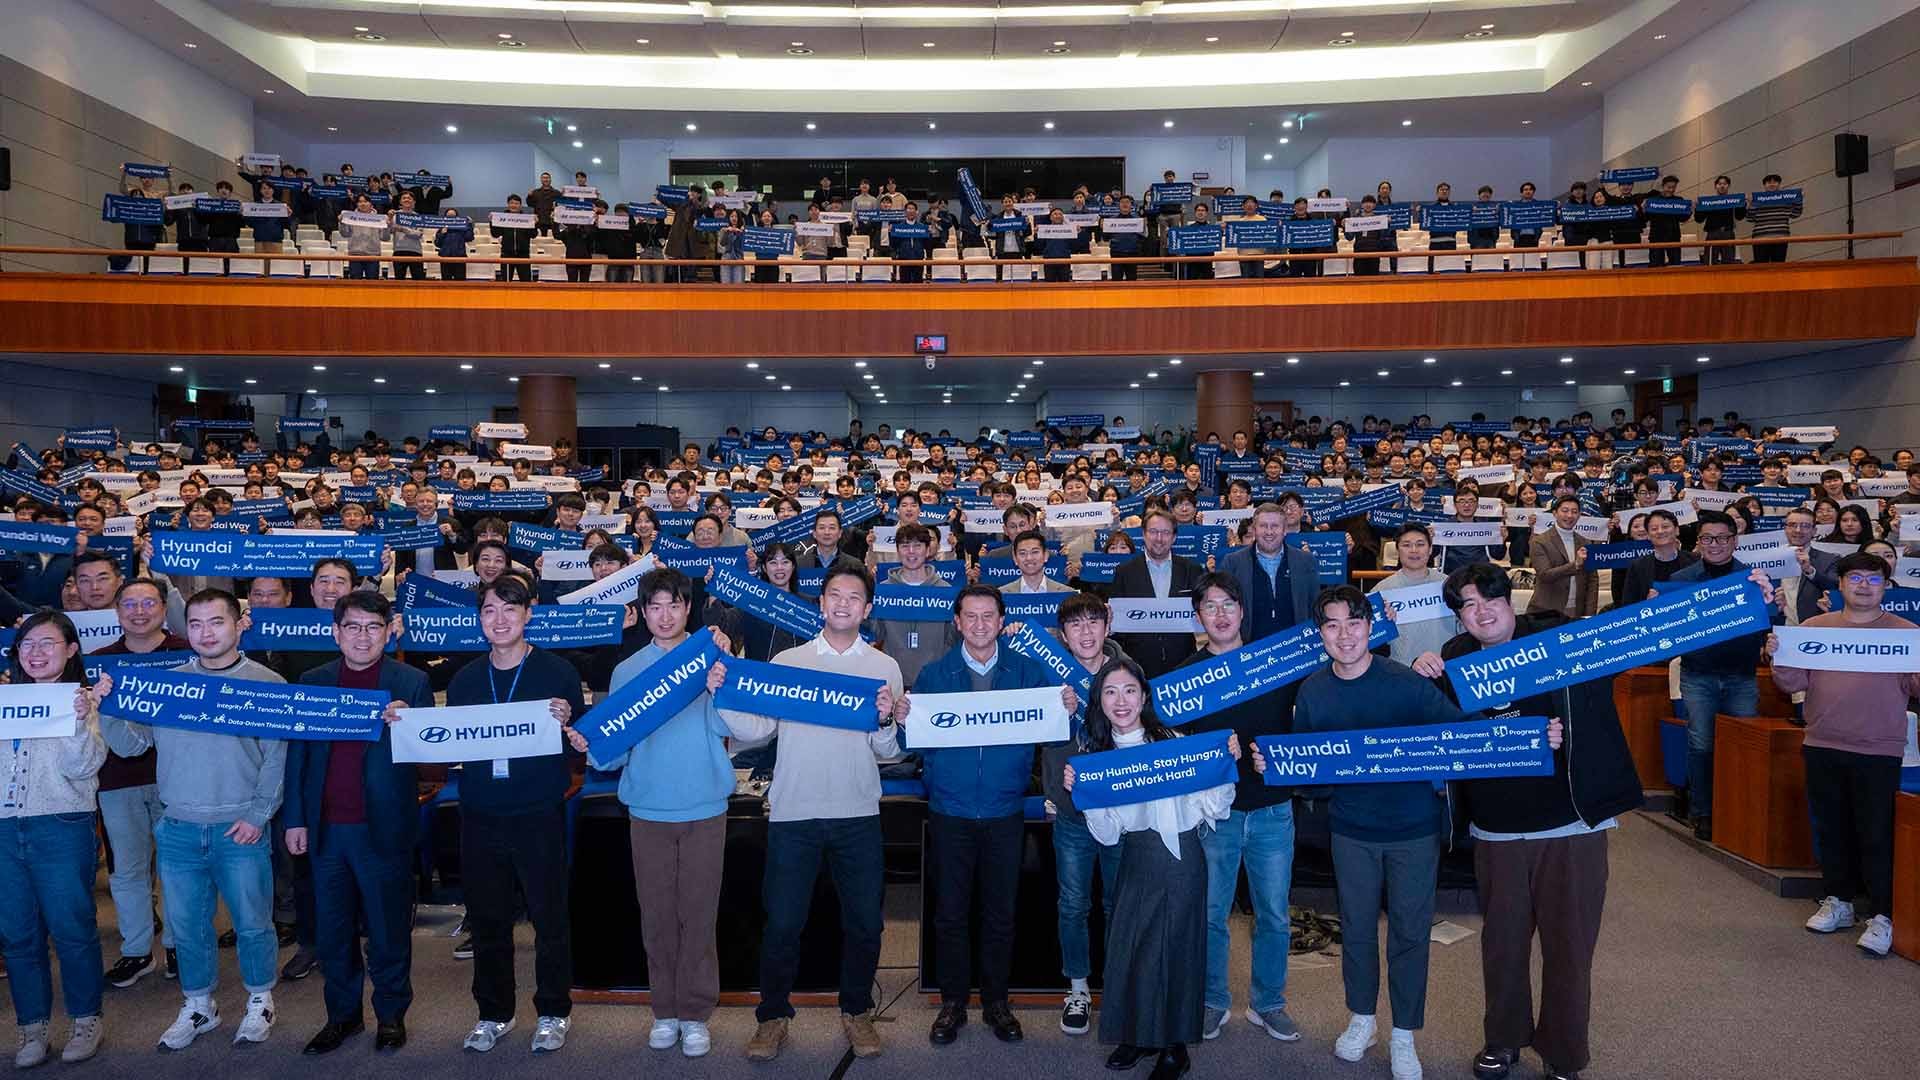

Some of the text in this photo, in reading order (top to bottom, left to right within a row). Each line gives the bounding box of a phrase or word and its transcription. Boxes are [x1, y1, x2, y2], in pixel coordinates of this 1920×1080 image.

[455, 494, 486, 503] Hyundai
[926, 512, 946, 521] Way
[1069, 511, 1102, 519] HYUNDAI
[1312, 504, 1342, 516] Hyundai
[1373, 510, 1403, 519] Hyundai
[229, 521, 250, 530] Way
[584, 522, 618, 530] HYUNDAI
[1314, 514, 1331, 524] Way
[1374, 516, 1390, 525] Way
[103, 525, 126, 534] NDAI
[515, 528, 556, 541] Hyundai
[40, 532, 70, 546] Way
[161, 539, 232, 554] Hyundai
[515, 536, 537, 548] Way
[1200, 534, 1208, 554] Way
[162, 554, 200, 571] Way
[667, 557, 712, 569] Hyundai
[1595, 551, 1635, 562] Hyundai
[1747, 560, 1785, 569] YUNDAI
[715, 580, 745, 602] Way
[718, 568, 770, 599] Hyundai
[404, 582, 416, 610] ndai
[873, 595, 954, 611] Hyundai Way
[1408, 595, 1442, 609] HYUN
[1577, 582, 1743, 640] Safety and Quality Alignment Progress
[1880, 600, 1908, 612] ndai
[261, 622, 333, 638] Hyunda
[408, 614, 477, 630] Hyundai
[79, 625, 122, 638] HYUN
[410, 630, 446, 645] Way
[1565, 601, 1736, 660] Integrity Tenacity Resilience Expertise
[1018, 623, 1074, 679] Hyundai
[1280, 650, 1304, 663] Tenacity
[1535, 614, 1754, 686] Agility Data-Driven Thinking Diversity and Inclusion
[1831, 644, 1909, 656] HYUNDAI
[1460, 642, 1548, 683] Hyundai
[119, 675, 207, 701] Hyundai
[1156, 661, 1231, 702] Hyundai
[1471, 676, 1516, 701] Way
[236, 689, 256, 698] Safety
[256, 691, 268, 699] and
[269, 692, 291, 701] Quality
[306, 696, 336, 705] Alignment
[600, 651, 709, 738] Hyundai Way
[737, 677, 865, 711] Hyundai Way
[1, 705, 50, 720] NDAI
[117, 693, 164, 718] Way
[216, 702, 243, 712] Integrity
[257, 706, 284, 716] Tenacity
[340, 712, 369, 721] Expertise
[1162, 694, 1205, 718] Way
[178, 713, 198, 723] Agility
[228, 718, 266, 729] Data-Driven
[265, 722, 292, 731] Thinking
[308, 725, 334, 734] Diversity
[965, 707, 1044, 727] HYUNDAI
[455, 722, 536, 741] HYUNDAI
[1380, 727, 1540, 745] Safety and Quality Alignment Progress
[1269, 739, 1351, 759] Hyundai
[1366, 750, 1393, 760] Integrity
[1407, 749, 1436, 759] Tenacity
[1497, 744, 1529, 753] Expertise
[1079, 748, 1224, 783] Stay Humble, Stay Hungry,
[1274, 760, 1318, 779] Way
[1335, 759, 1542, 777] Agility Data-Driven Thinking Diversity and Inclusion
[1111, 767, 1196, 791] and Work Hard!
